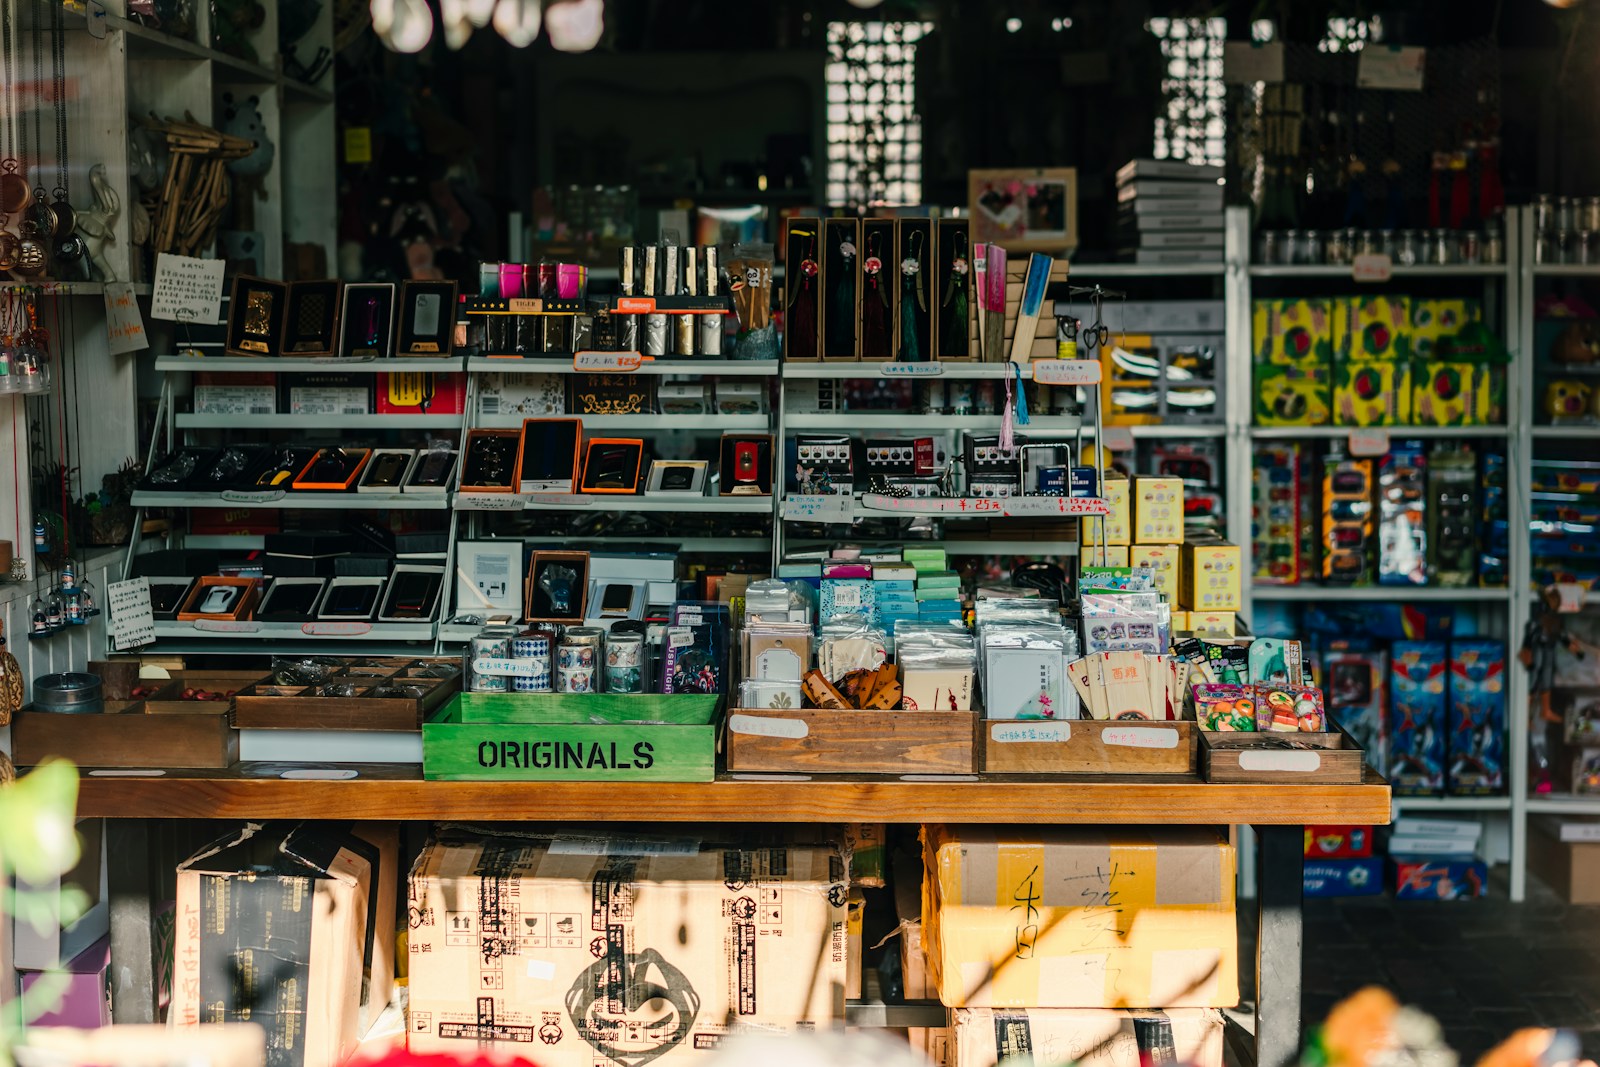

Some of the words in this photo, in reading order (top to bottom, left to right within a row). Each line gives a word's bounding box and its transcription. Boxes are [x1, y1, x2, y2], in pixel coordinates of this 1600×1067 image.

[580, 357, 615, 365] 打火机
[667, 646, 675, 666] USB
[477, 740, 655, 769] ORIGINALS
[832, 921, 842, 962] 防潮防压
[1040, 1032, 1137, 1064] 花色胶带
